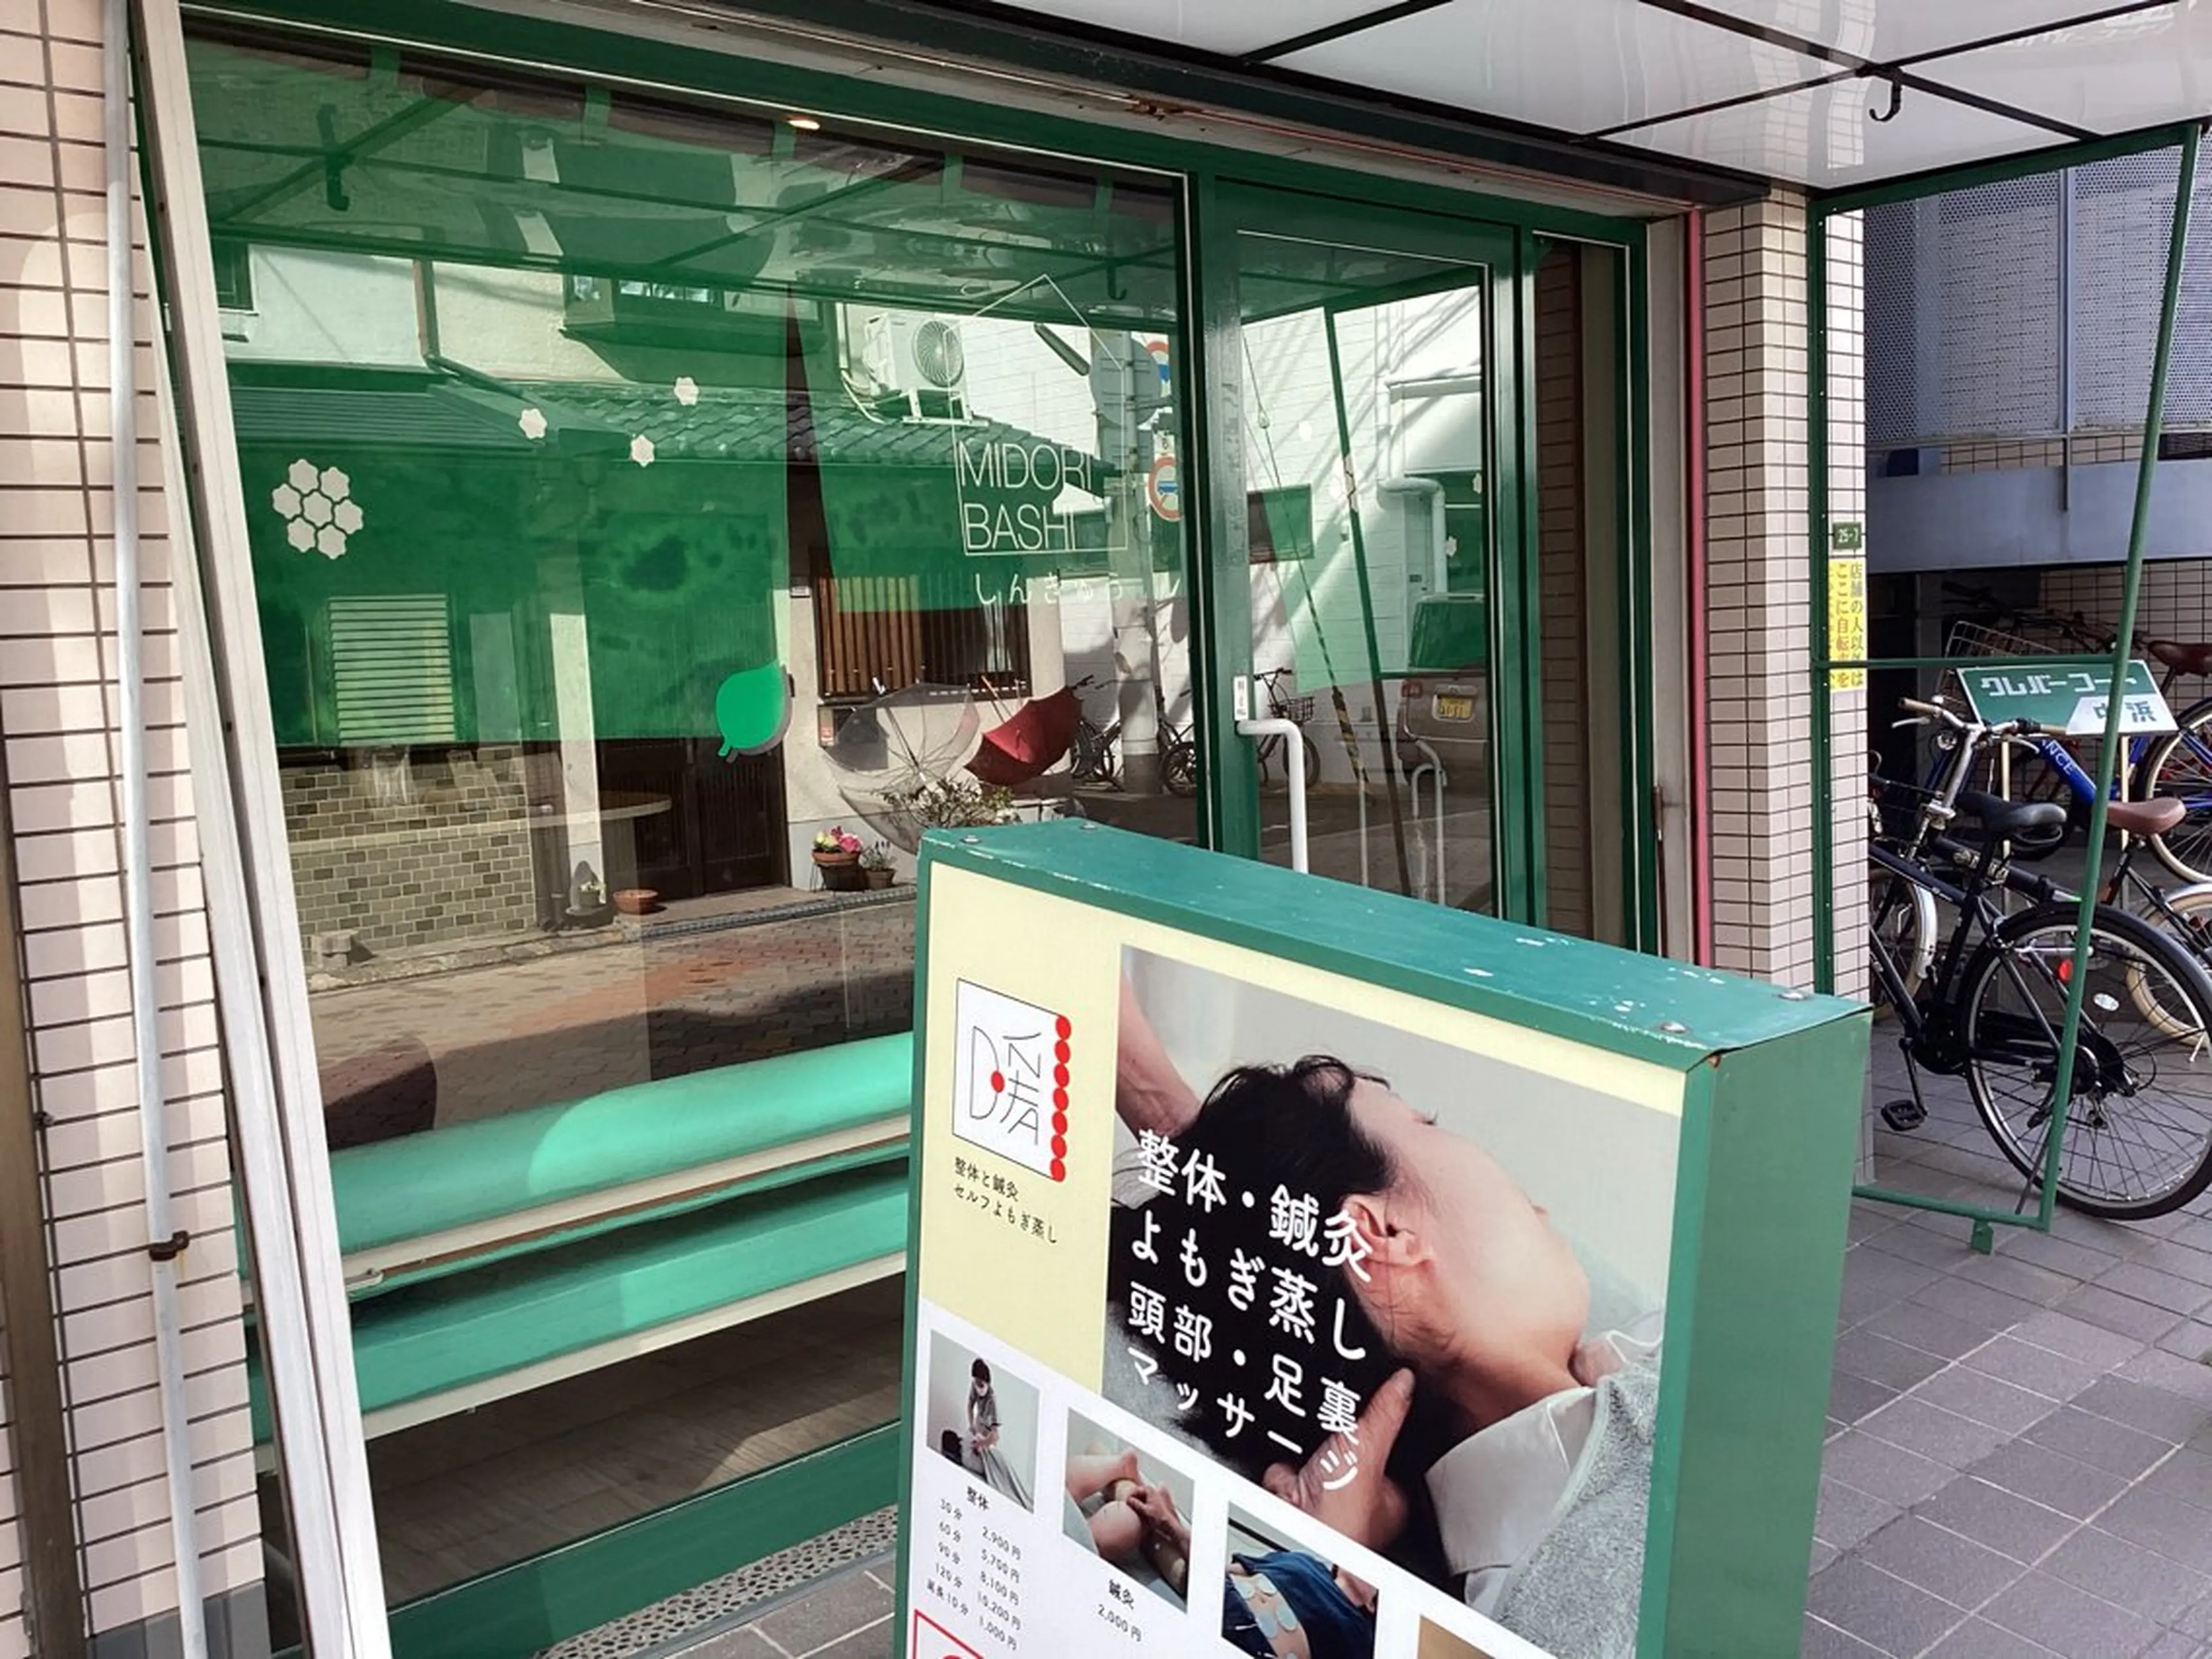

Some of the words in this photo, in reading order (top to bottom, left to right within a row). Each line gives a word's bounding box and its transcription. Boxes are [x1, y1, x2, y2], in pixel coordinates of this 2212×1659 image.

[957, 441, 1093, 491] MIDORI
[964, 504, 1075, 551] BASHI
[954, 1183, 1057, 1244] セルフよもぎ蒸し
[955, 1156, 1019, 1202] 整体と鍼灸
[1138, 1128, 1373, 1283] 整体・鍼灸
[1131, 1210, 1366, 1361] よもぎ蒸し
[1128, 1281, 1361, 1445] 頭部・足裏
[1127, 1346, 1358, 1490] マッサージ
